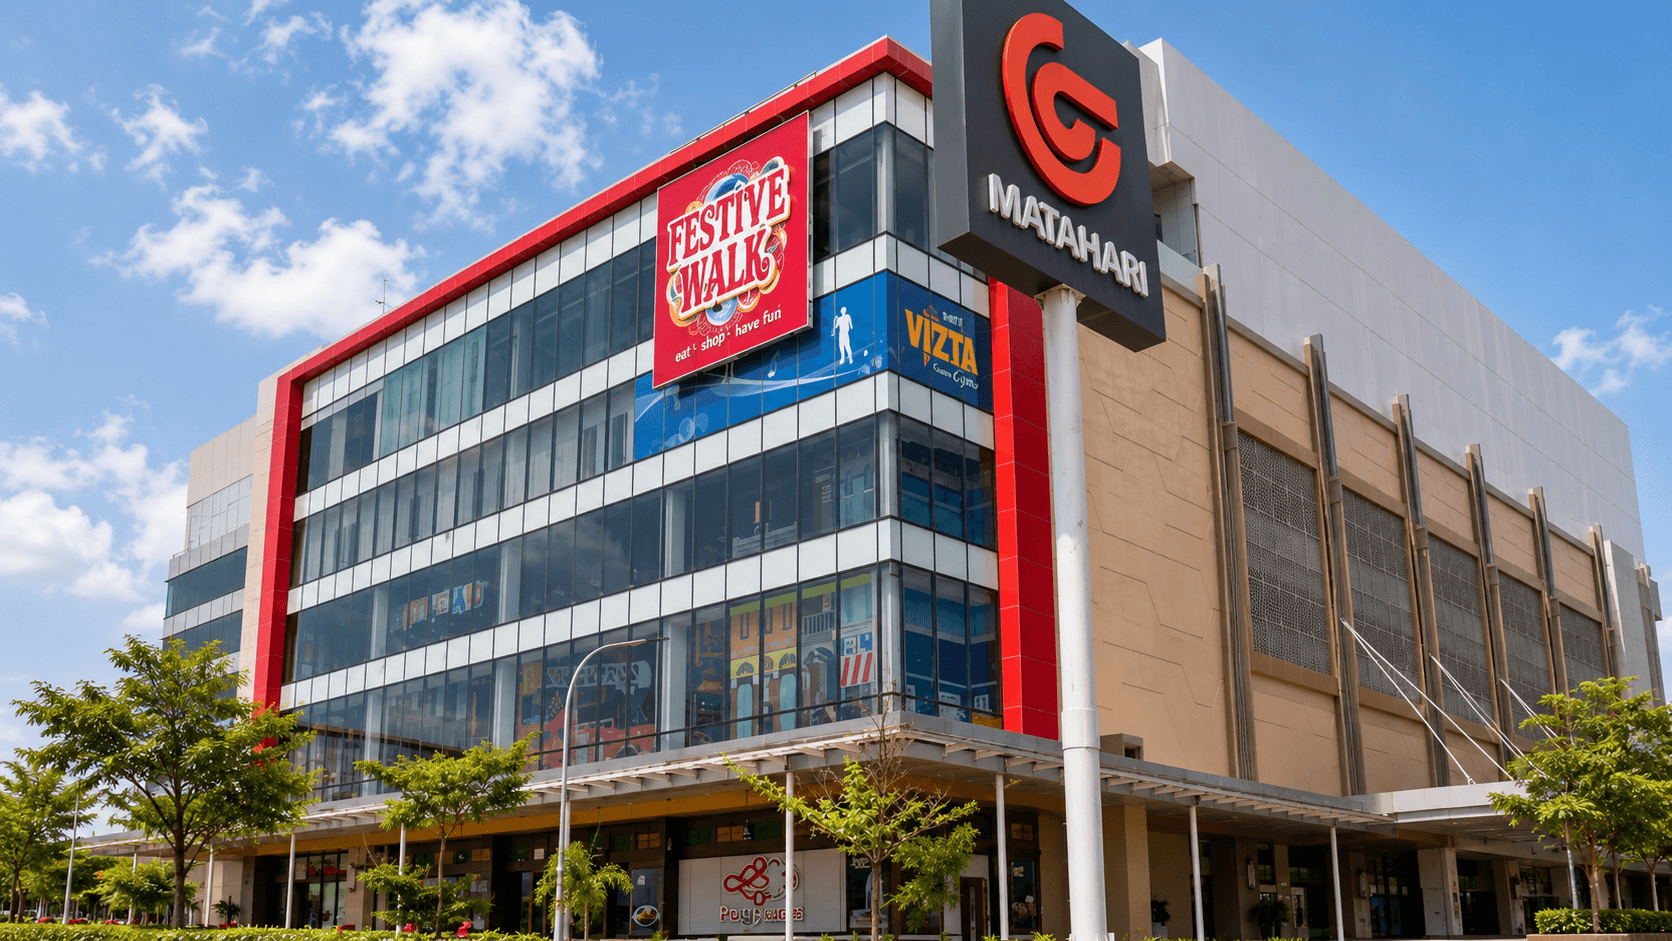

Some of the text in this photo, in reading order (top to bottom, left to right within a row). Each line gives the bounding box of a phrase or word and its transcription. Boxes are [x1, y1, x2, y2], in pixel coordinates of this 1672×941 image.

[668, 166, 786, 269] FESTIVE
[988, 173, 1148, 298] MATAHARI
[679, 228, 772, 313] WALK
[675, 307, 782, 363] eat shop have fun
[905, 308, 979, 376] VIZTA
